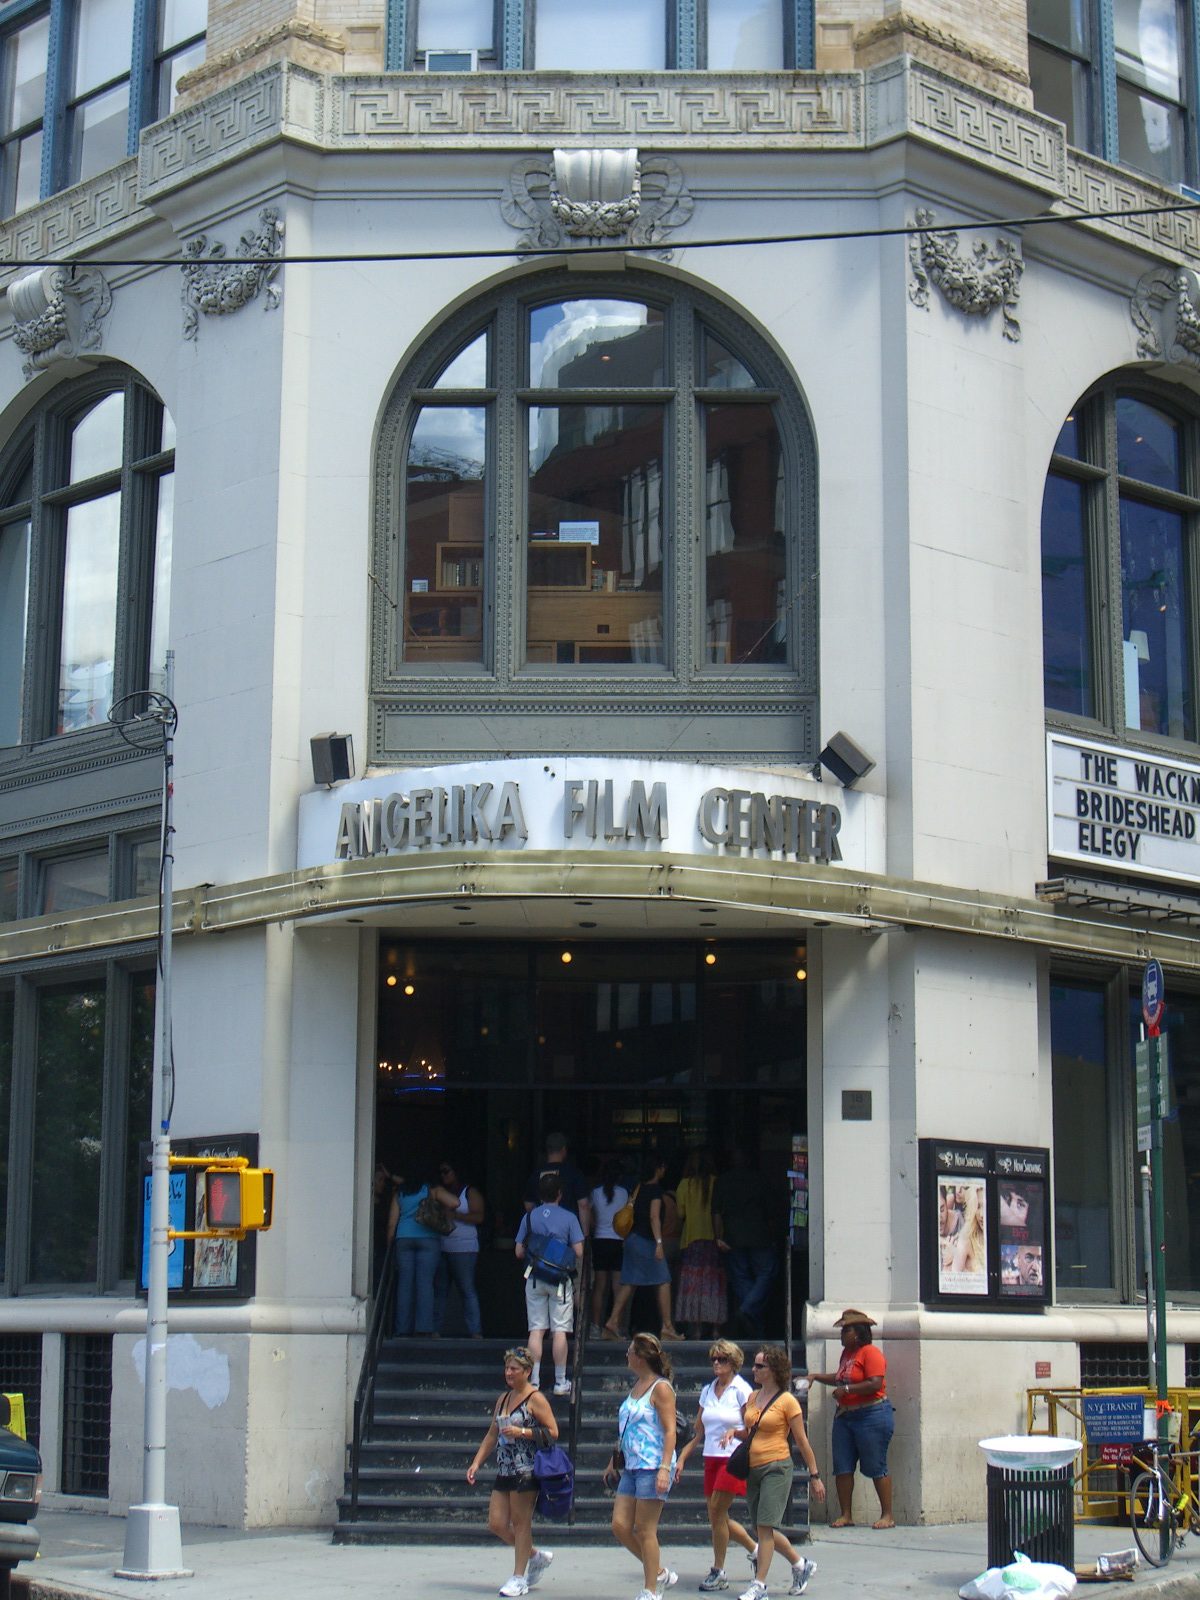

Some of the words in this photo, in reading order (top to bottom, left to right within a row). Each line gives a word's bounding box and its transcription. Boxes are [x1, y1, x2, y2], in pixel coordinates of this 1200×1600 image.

[1081, 752, 1117, 786] THE
[335, 782, 529, 860] ANGELIKA
[564, 779, 669, 841] FILM
[699, 787, 843, 862] CENTER
[1077, 789, 1195, 839] BRIDESHEAD
[1079, 822, 1140, 860] ELEGY
[1106, 1402, 1137, 1411] TRANSIT
